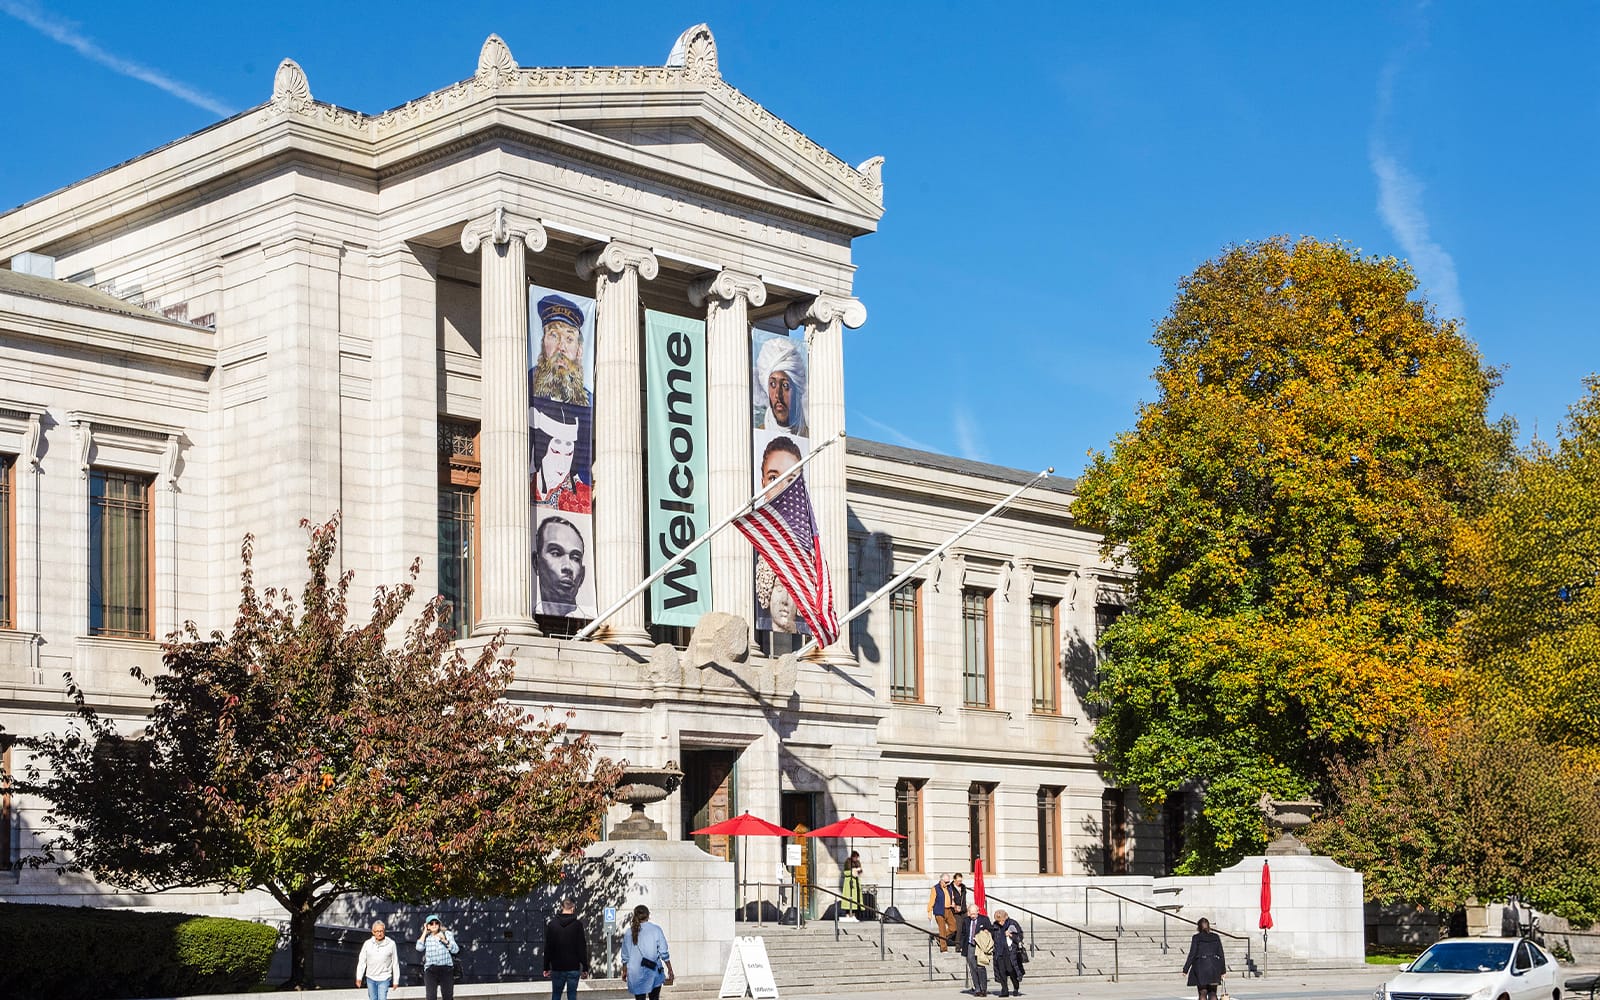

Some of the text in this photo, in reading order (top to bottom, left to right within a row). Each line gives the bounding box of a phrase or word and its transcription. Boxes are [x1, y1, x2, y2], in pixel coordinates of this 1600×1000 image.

[662, 193, 685, 215] OF
[701, 204, 748, 233] FINE
[759, 223, 808, 249] ARTS
[659, 331, 698, 610] Welcome
